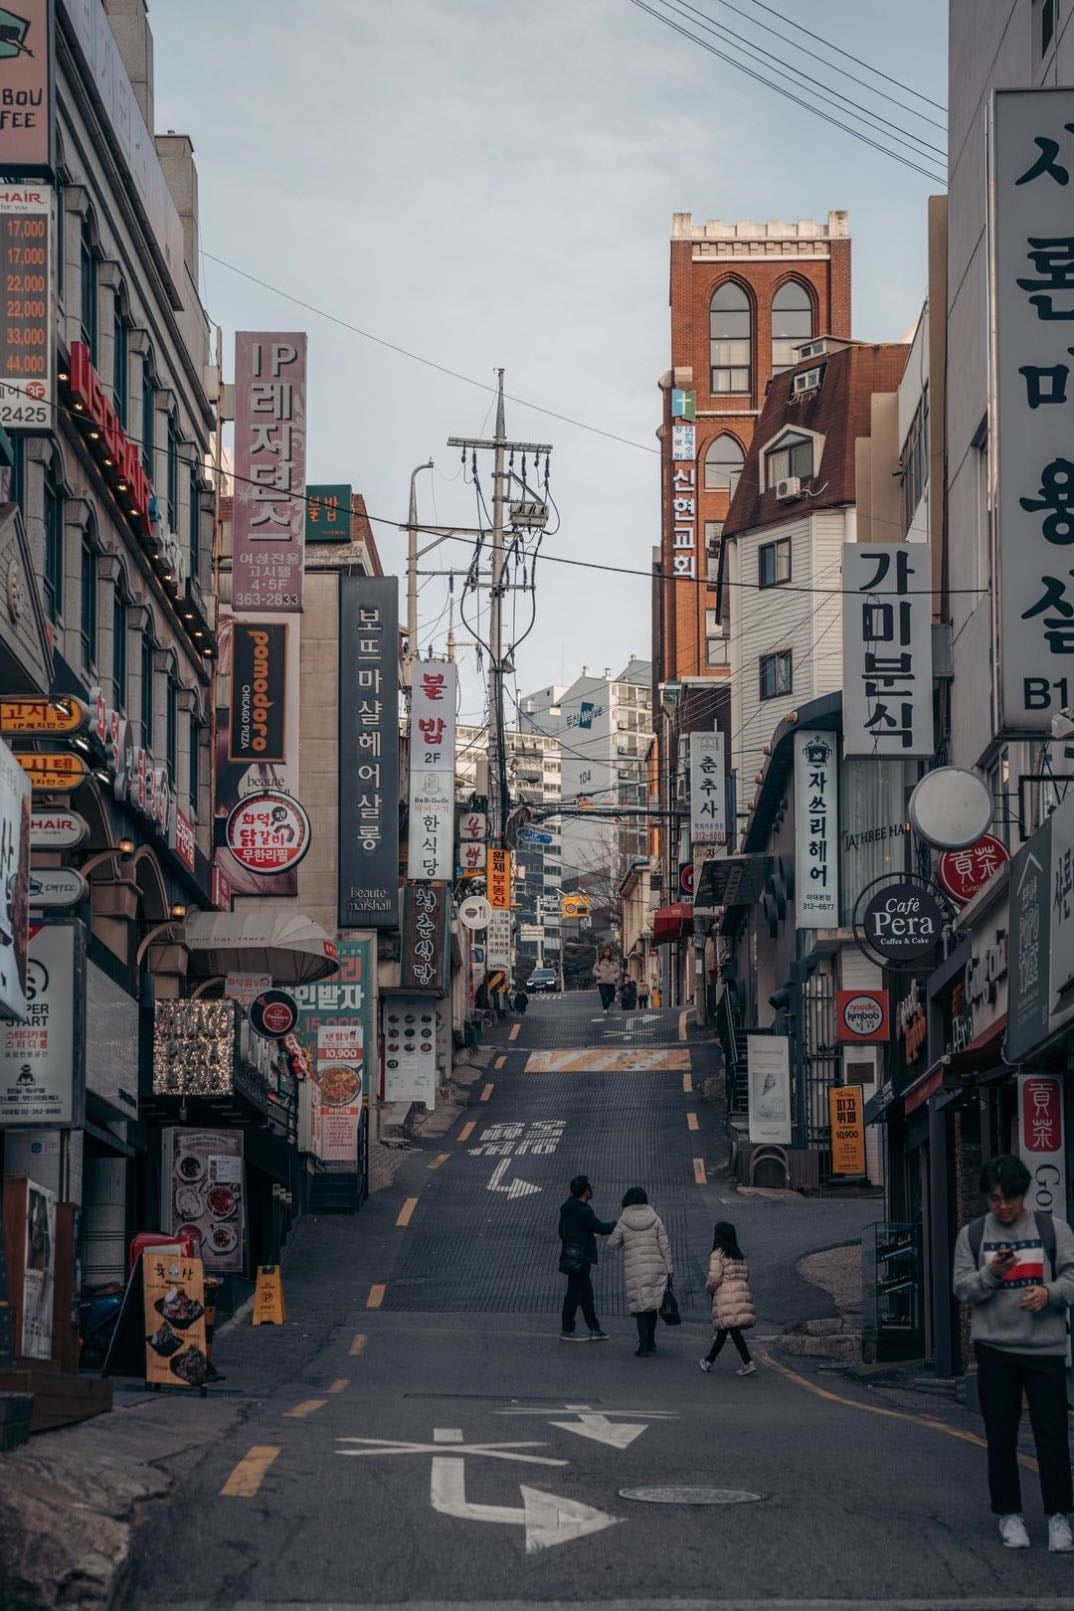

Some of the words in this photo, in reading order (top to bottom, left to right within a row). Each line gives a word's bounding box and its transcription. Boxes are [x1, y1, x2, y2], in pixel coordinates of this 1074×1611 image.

[27, 384, 44, 397] 3F
[673, 469, 695, 579] 신현교회
[240, 552, 299, 565] 여성전용
[236, 592, 300, 606] 363-2833
[859, 550, 915, 748] 가미분식
[248, 630, 274, 752] pomodoro
[242, 684, 250, 723] CHICAGO
[418, 673, 448, 745] 불밥
[241, 725, 249, 750] PIZZA
[18, 758, 73, 778] 시텔
[424, 753, 441, 764] 2F
[579, 771, 592, 784] 104
[699, 756, 718, 818] 춘추사
[240, 829, 285, 848] 닭갈비
[808, 771, 828, 887] 자쓰리헤어
[422, 815, 440, 876] 한식당
[242, 849, 288, 864] 무한리필
[873, 912, 934, 936] Pera
[880, 937, 902, 946] Coffee
[904, 937, 910, 945] &
[912, 937, 929, 945] Cake
[847, 1011, 880, 1021] kimbob
[325, 1050, 356, 1060] 10,900
